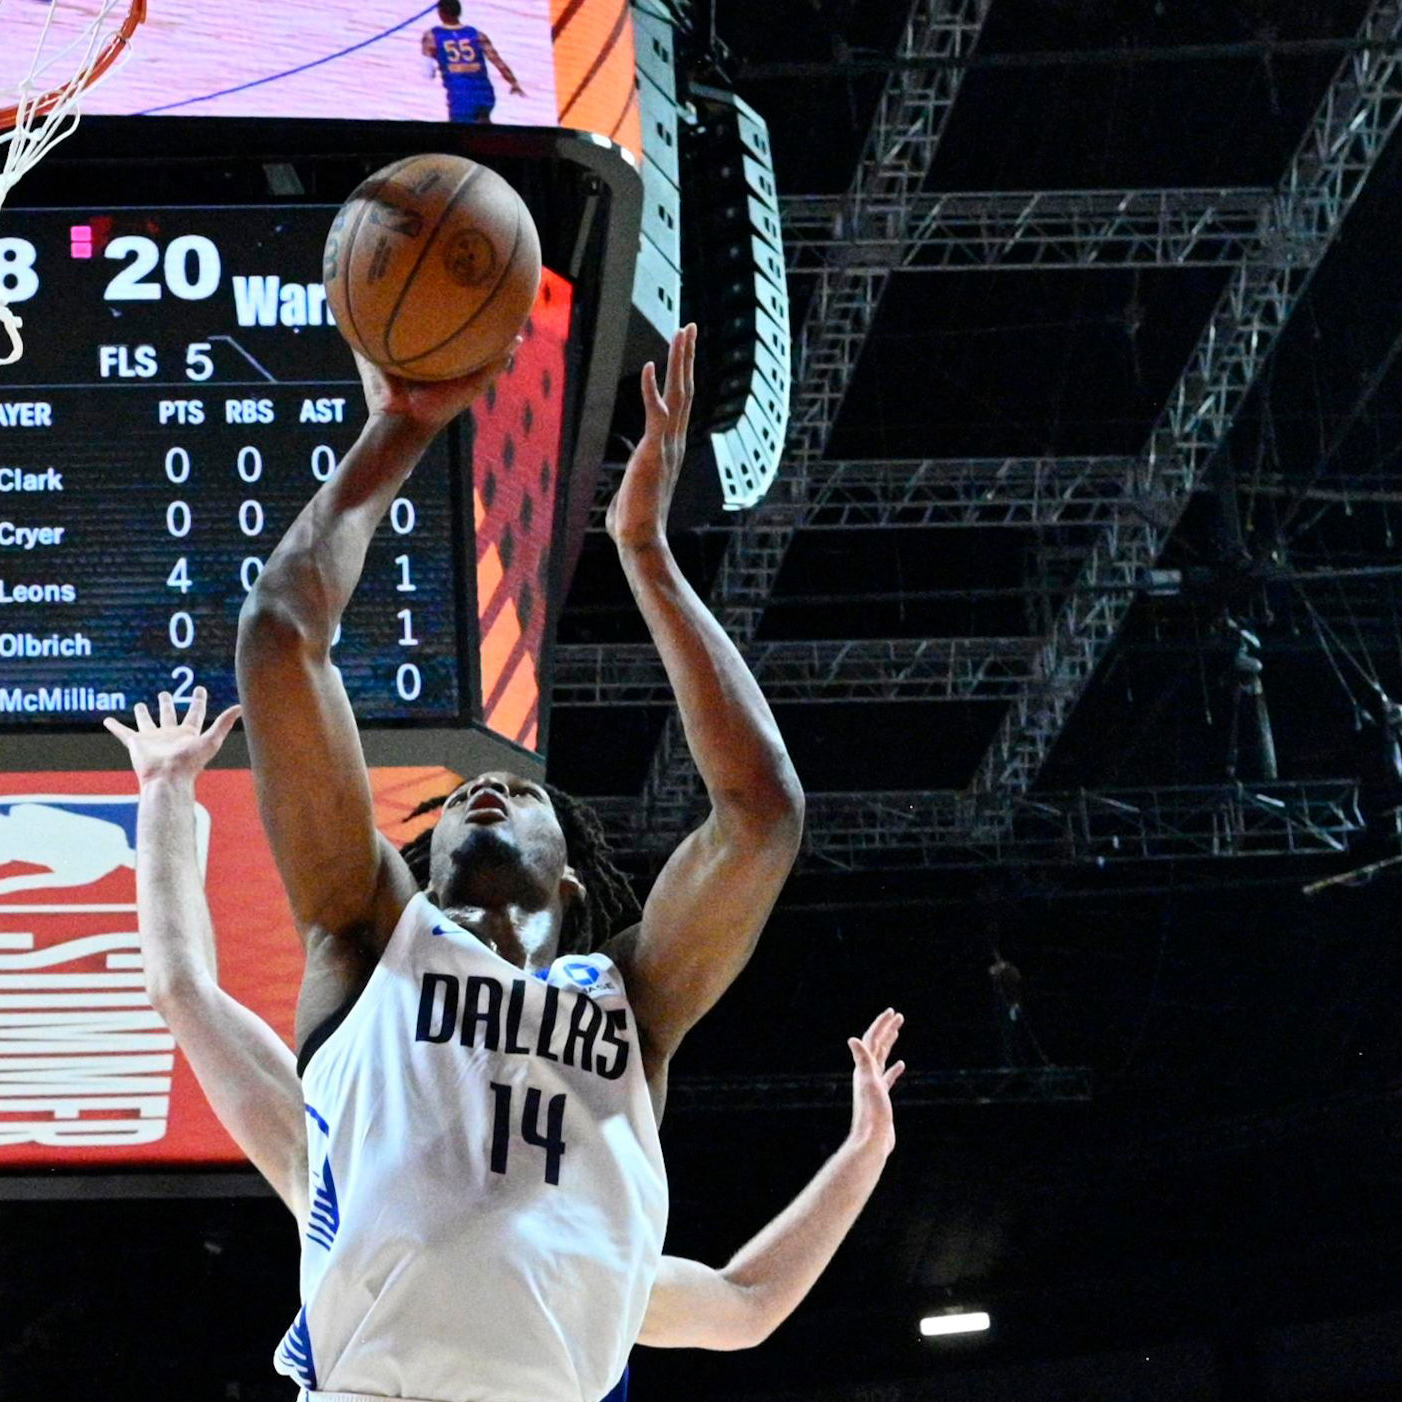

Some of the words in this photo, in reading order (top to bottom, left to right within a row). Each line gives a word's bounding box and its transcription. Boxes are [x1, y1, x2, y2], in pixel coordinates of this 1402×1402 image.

[104, 235, 221, 300] 20
[99, 345, 158, 378] FLS
[186, 343, 213, 380] 5
[159, 401, 204, 425] PTS
[226, 400, 274, 424] RBS
[300, 399, 345, 423] AST
[165, 447, 189, 483] 0
[238, 446, 262, 482] 0
[311, 445, 336, 481] 0
[167, 501, 191, 537] 0
[239, 500, 263, 536] 0
[390, 498, 415, 534] 0
[167, 558, 192, 593] 4
[395, 555, 416, 591] 1
[170, 612, 194, 648] 0
[397, 609, 418, 645] 1
[171, 667, 195, 702] 2
[397, 664, 421, 700] 0
[416, 972, 630, 1080] DALLAS
[489, 1081, 567, 1187] 14
